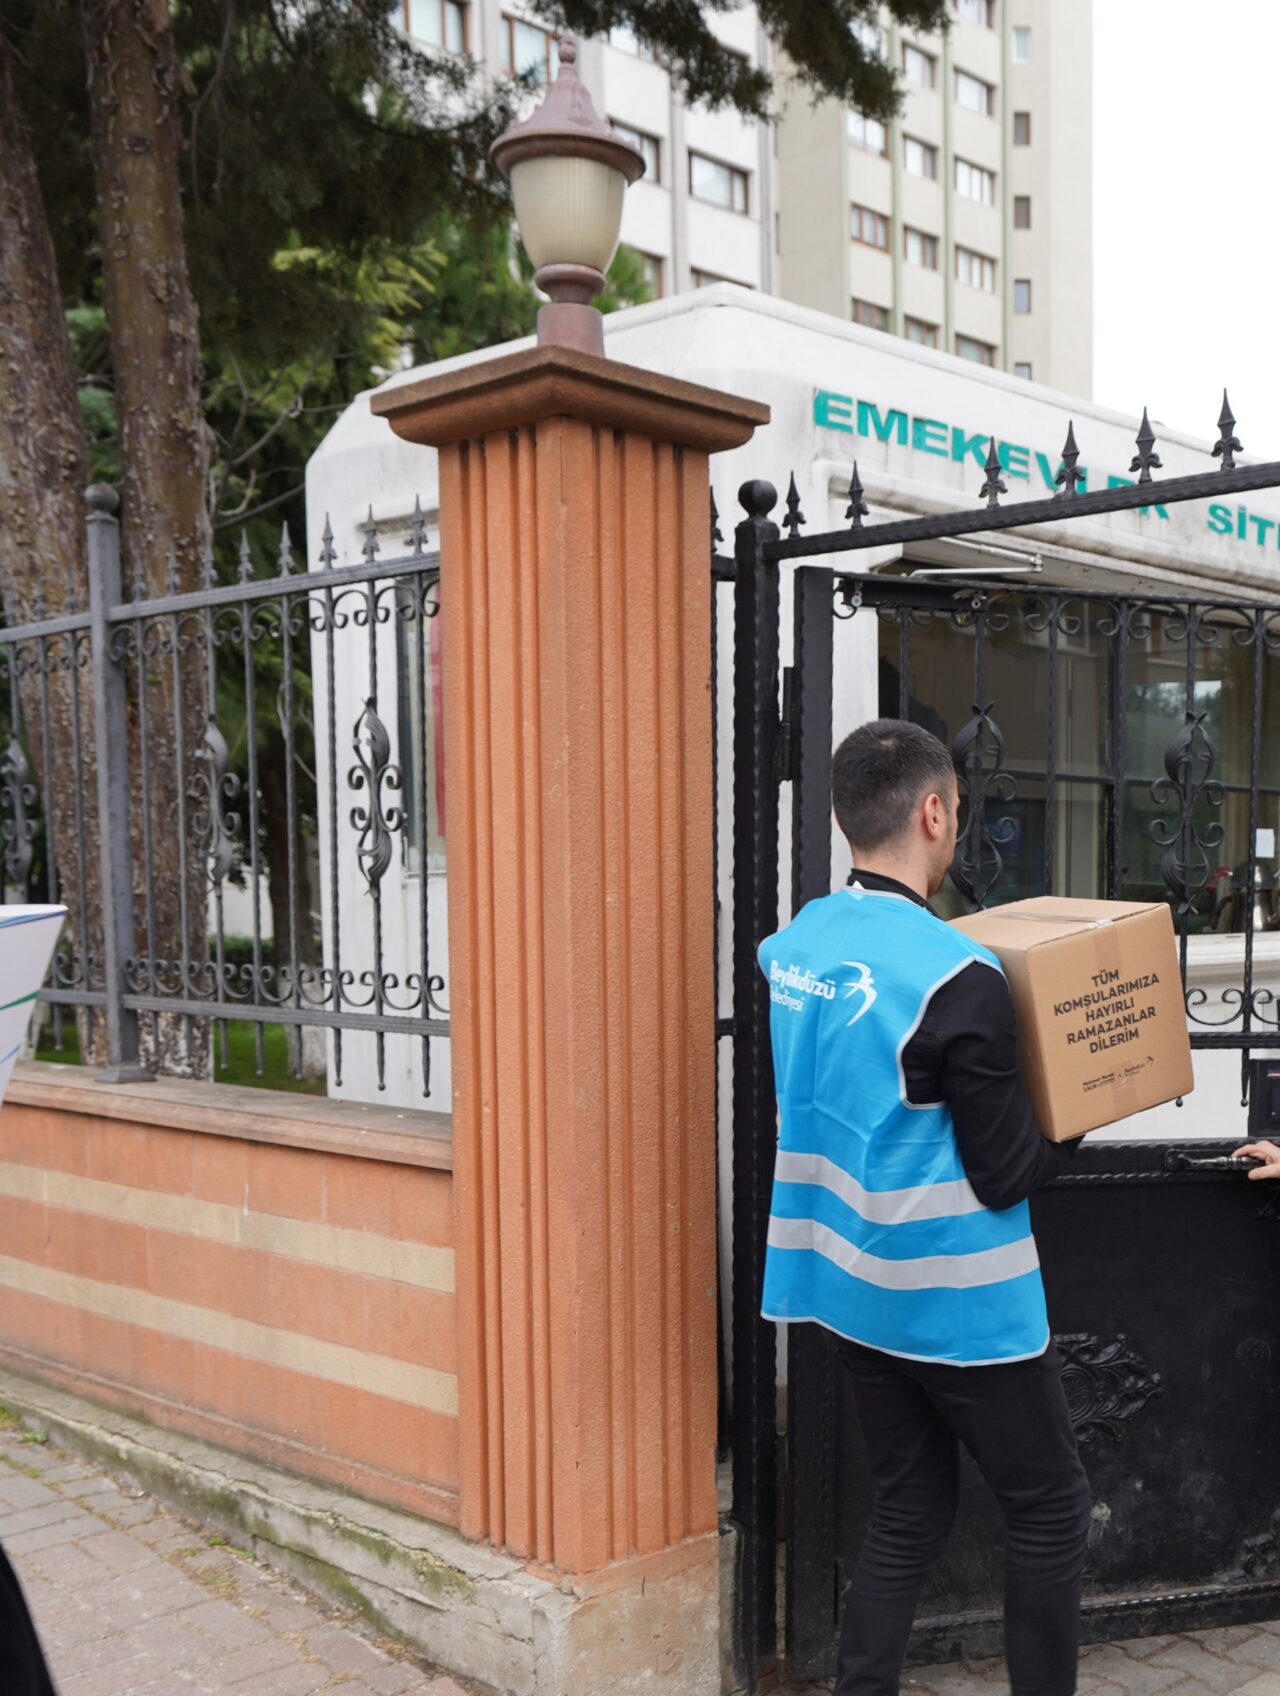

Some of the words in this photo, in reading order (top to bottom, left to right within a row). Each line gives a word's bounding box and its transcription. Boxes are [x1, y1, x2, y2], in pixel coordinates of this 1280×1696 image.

[1091, 968, 1120, 987] TÜM
[1053, 972, 1160, 1017] KOMŞULARIMIZA
[1085, 996, 1135, 1022] HAYIRLI
[1066, 1005, 1157, 1045] RAMAZANLAR
[1089, 1027, 1139, 1054] DİLERİM
